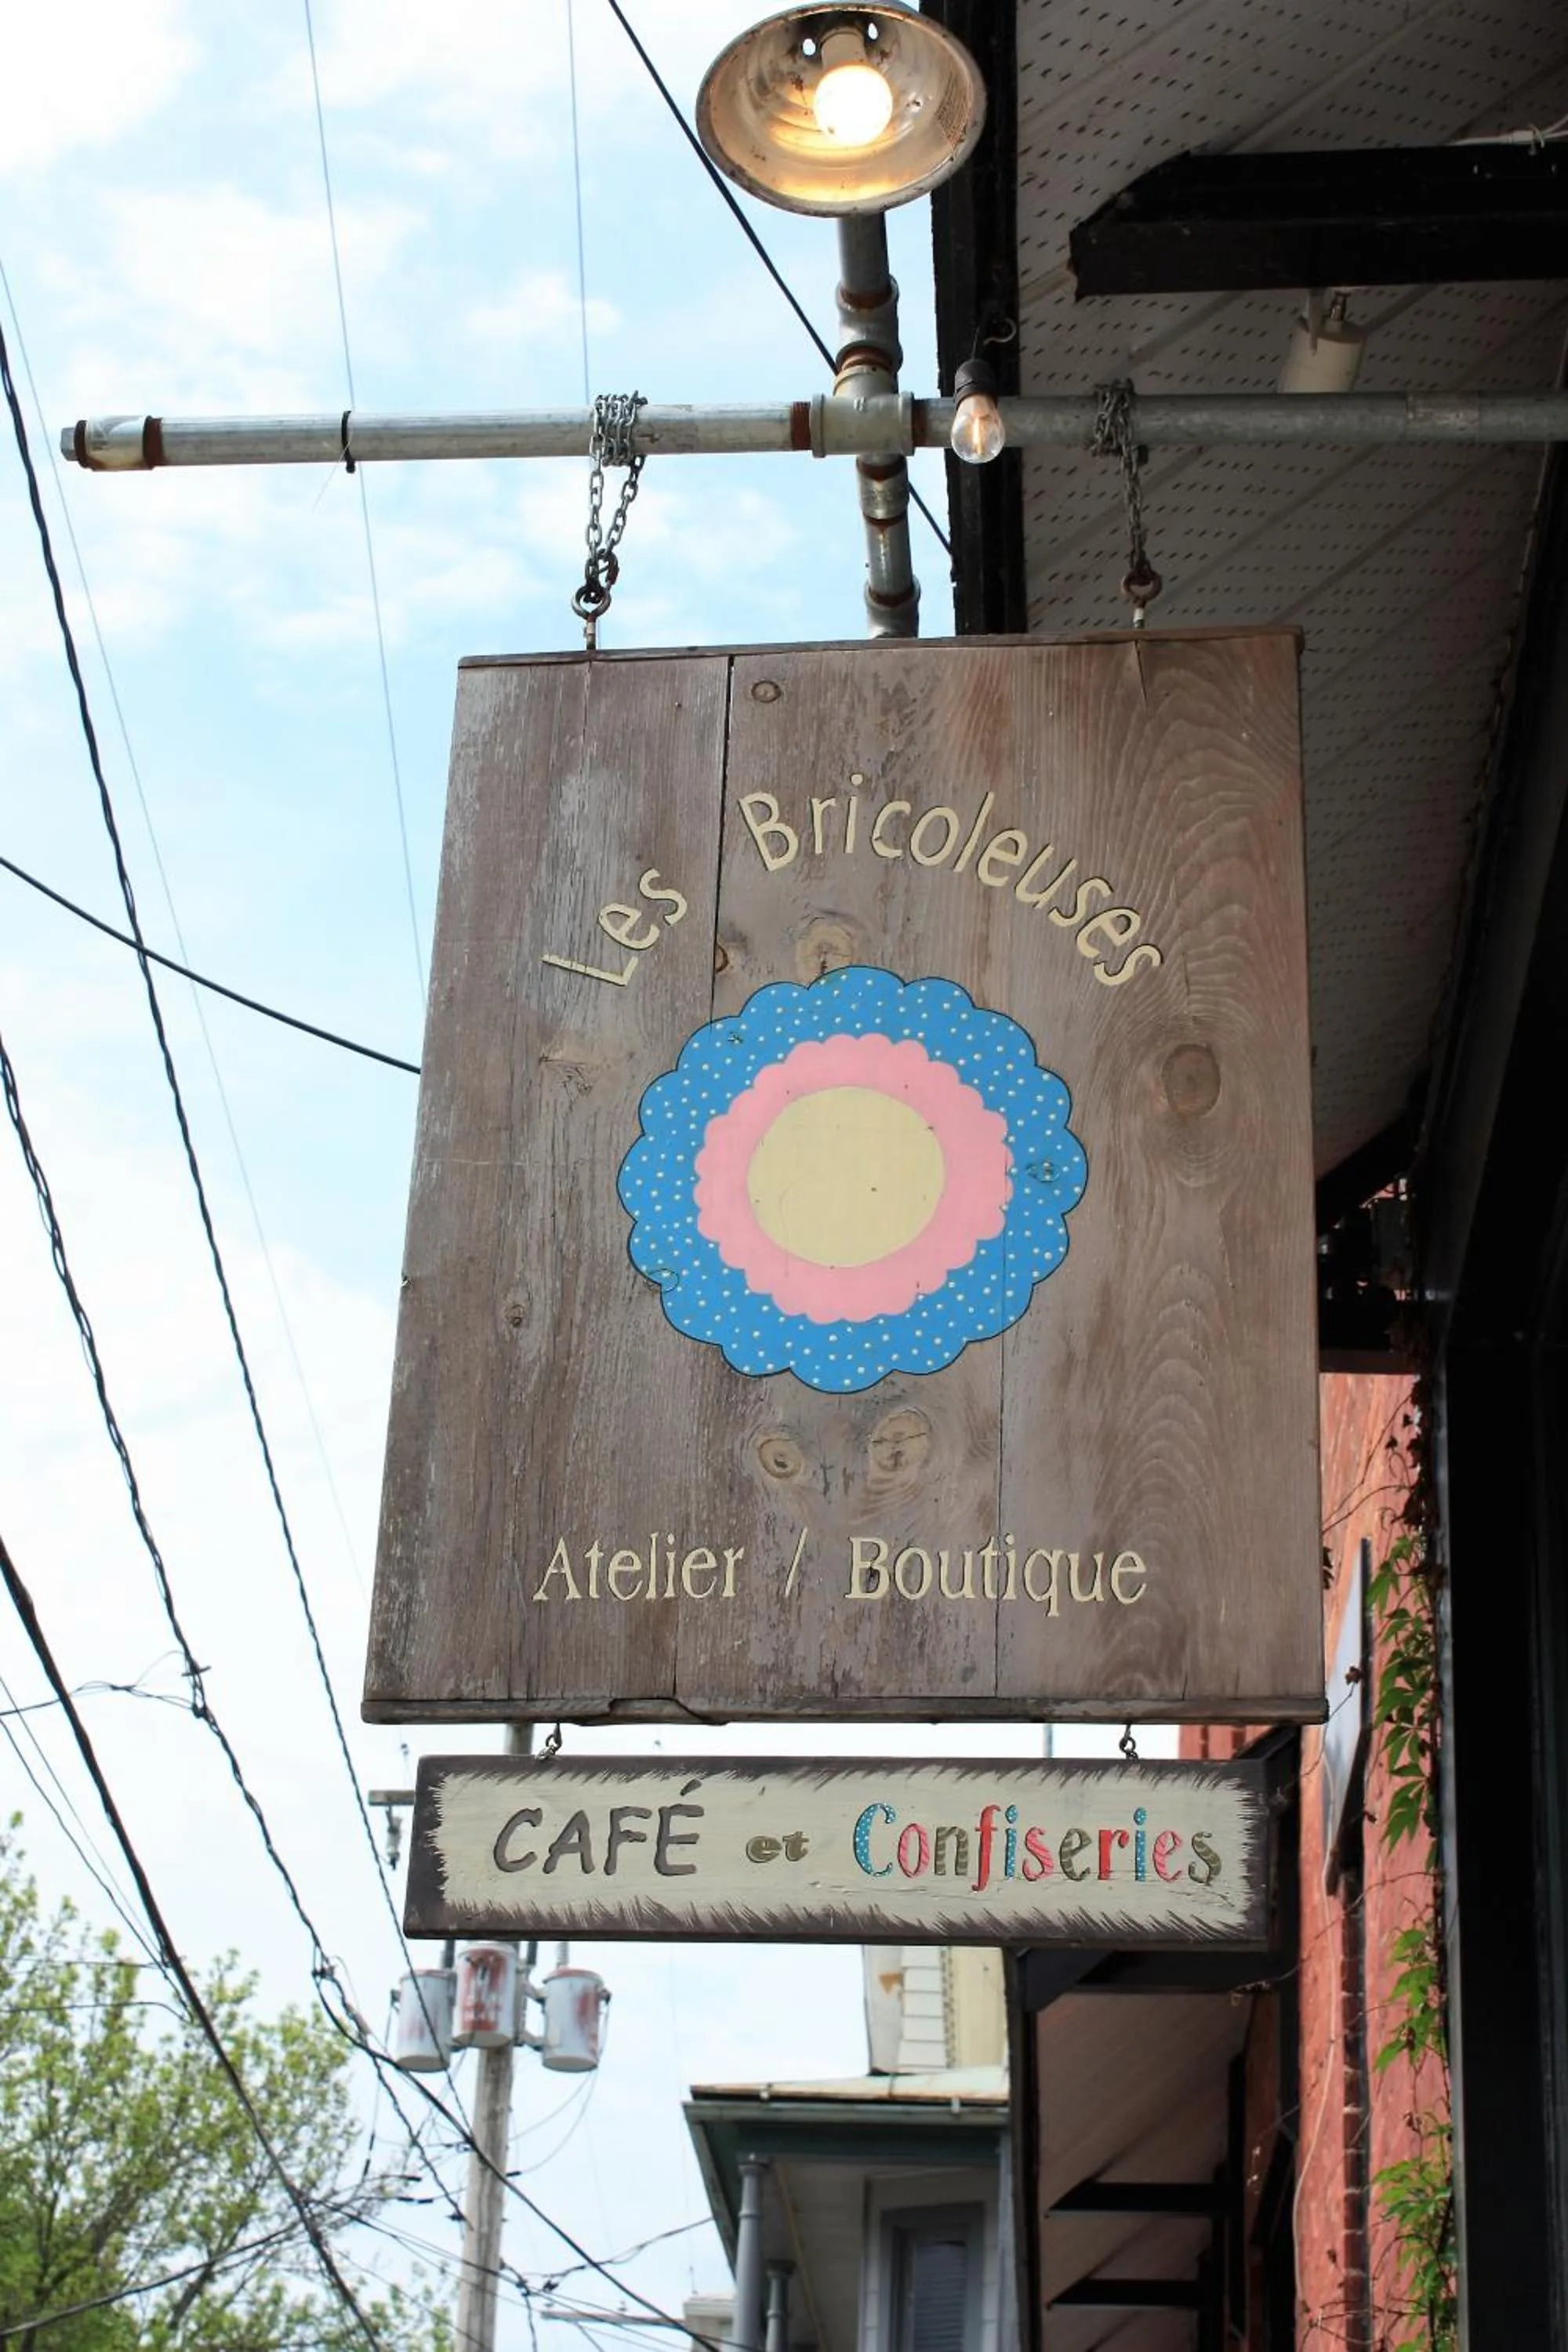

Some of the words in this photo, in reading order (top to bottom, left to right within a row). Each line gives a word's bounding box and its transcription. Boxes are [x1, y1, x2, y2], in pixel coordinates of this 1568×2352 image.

[542, 868, 688, 987] Les
[739, 773, 1163, 987] Bricoleuses
[533, 1533, 745, 1601] Atelier
[845, 1534, 1148, 1617] Boutique
[492, 1780, 705, 1875] CAFÉ
[745, 1831, 808, 1863] et
[852, 1802, 1221, 1891] Confiseries
